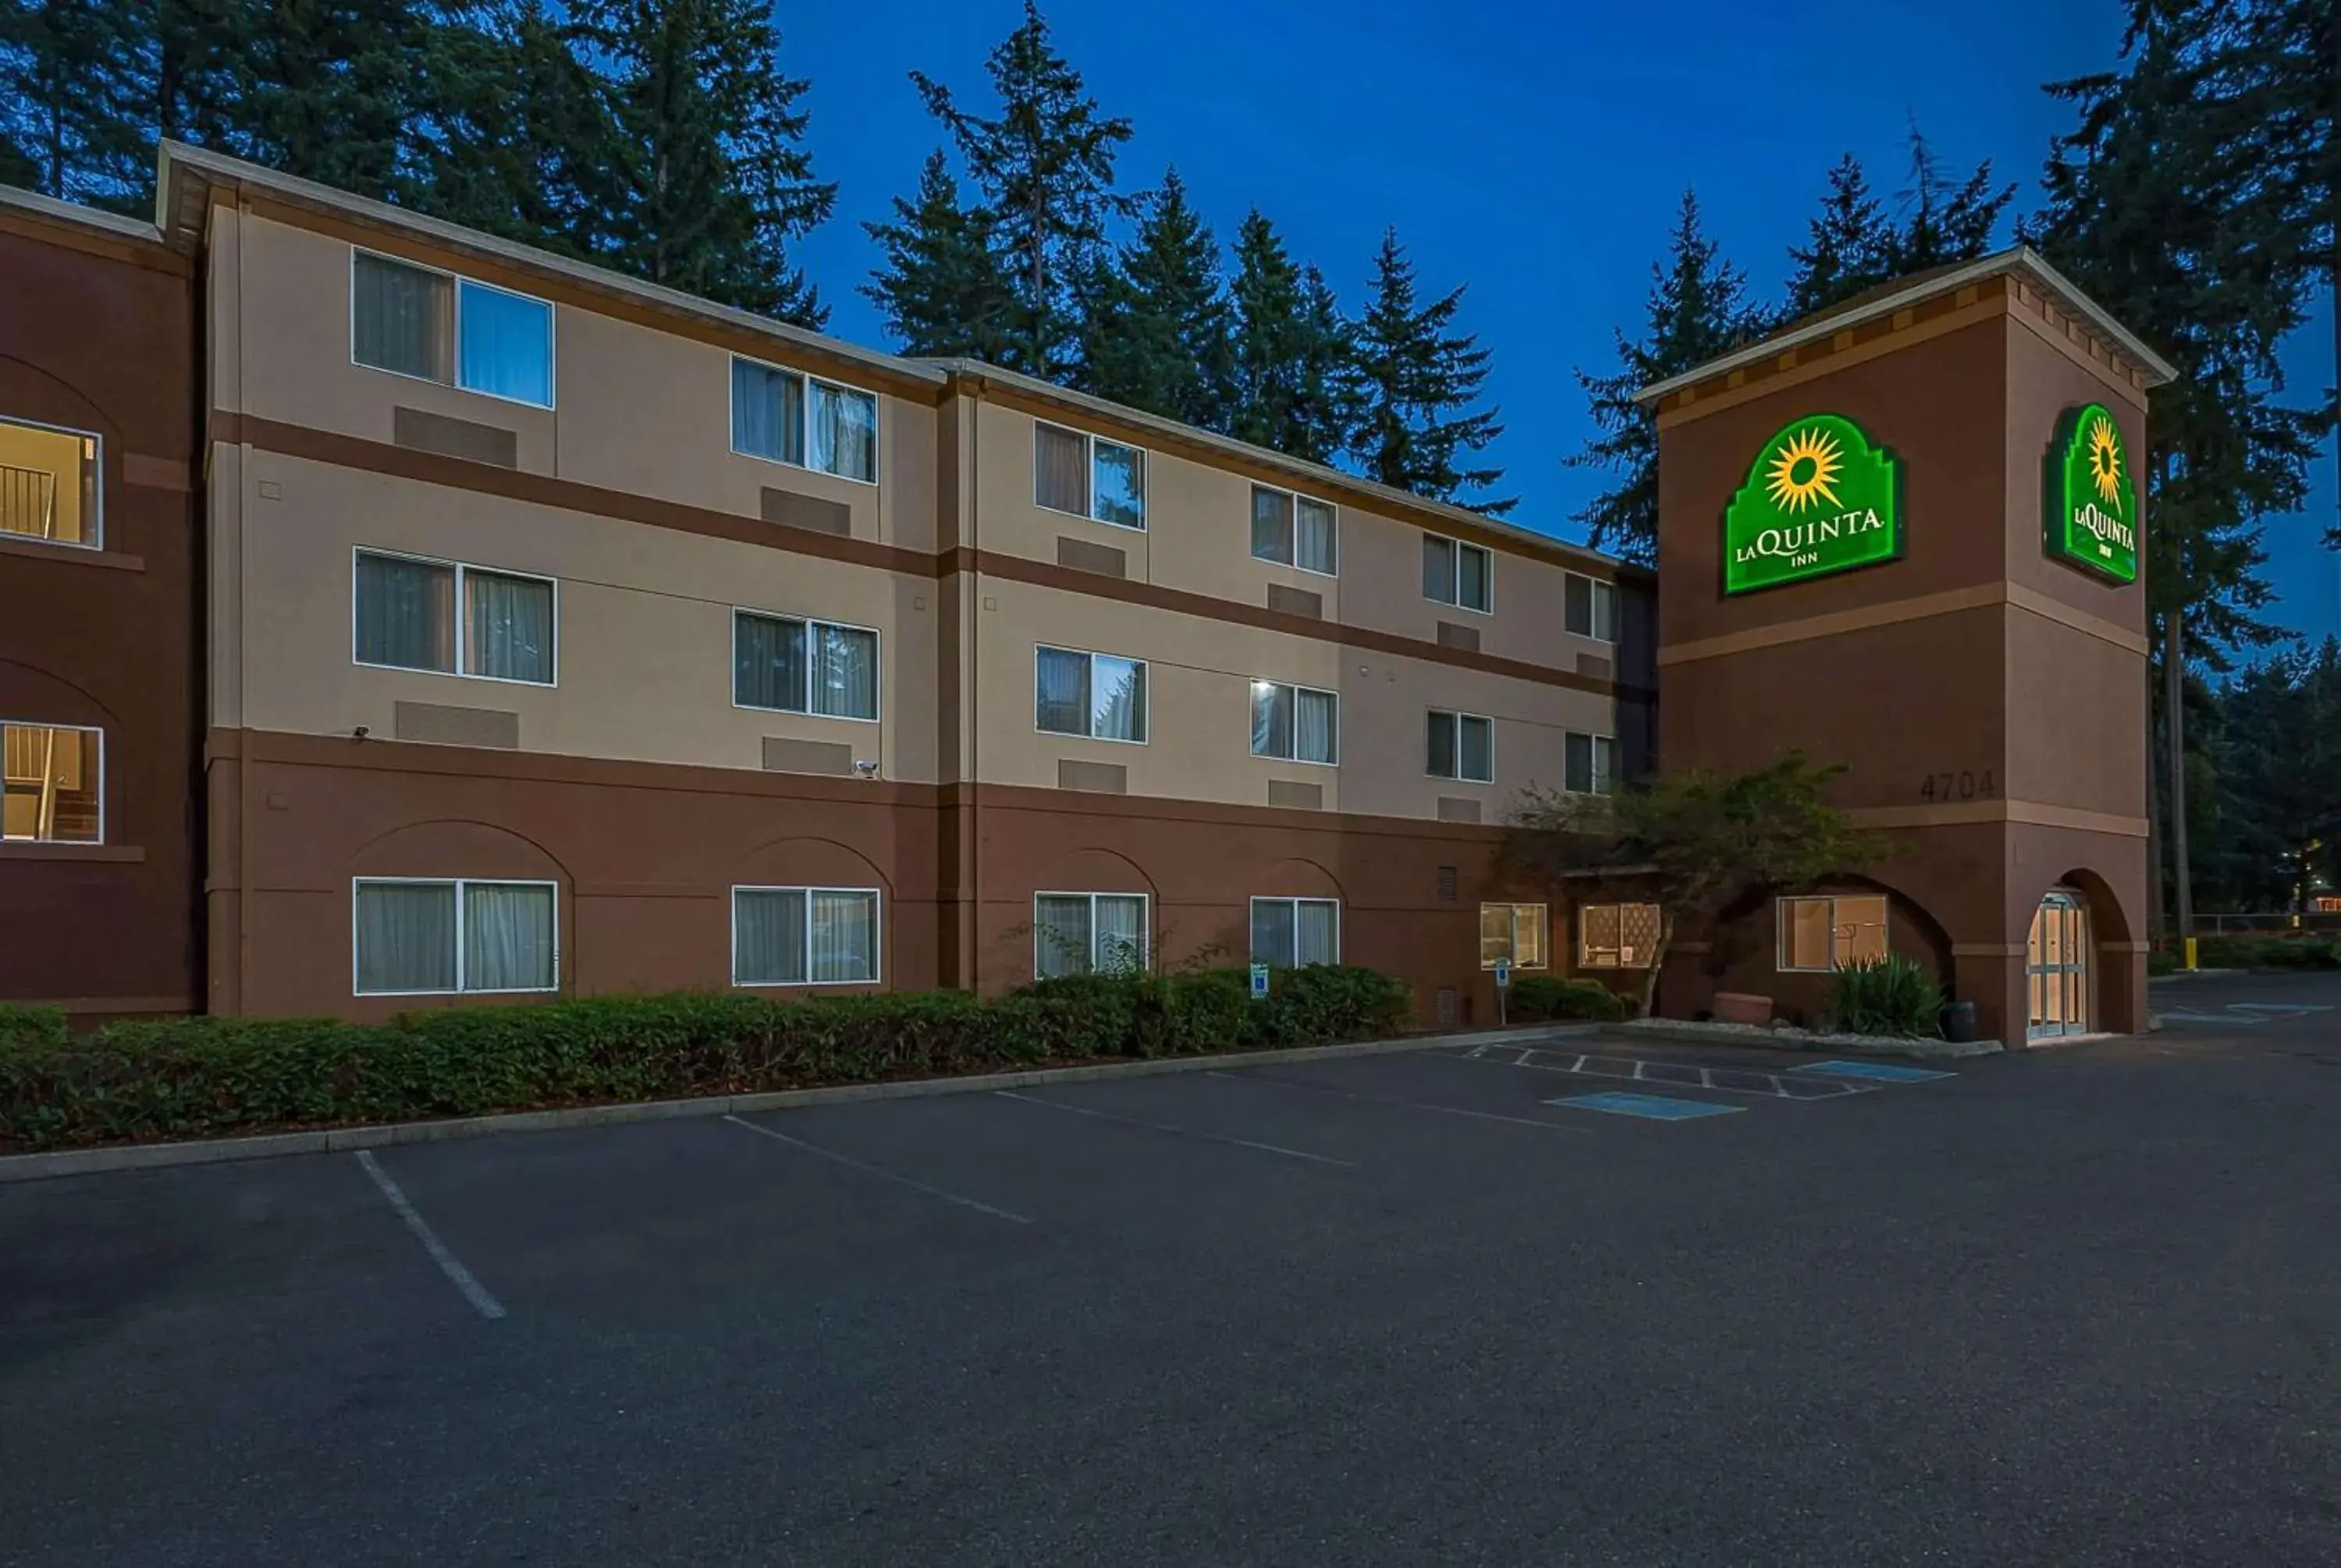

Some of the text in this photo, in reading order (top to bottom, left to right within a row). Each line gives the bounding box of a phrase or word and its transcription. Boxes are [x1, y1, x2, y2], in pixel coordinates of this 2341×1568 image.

[1736, 509, 1883, 562] LA QUINTA
[2074, 507, 2086, 527] LA
[2086, 502, 2134, 552] QUINTA
[1792, 552, 1817, 567] INN
[1920, 770, 1995, 802] 4704
